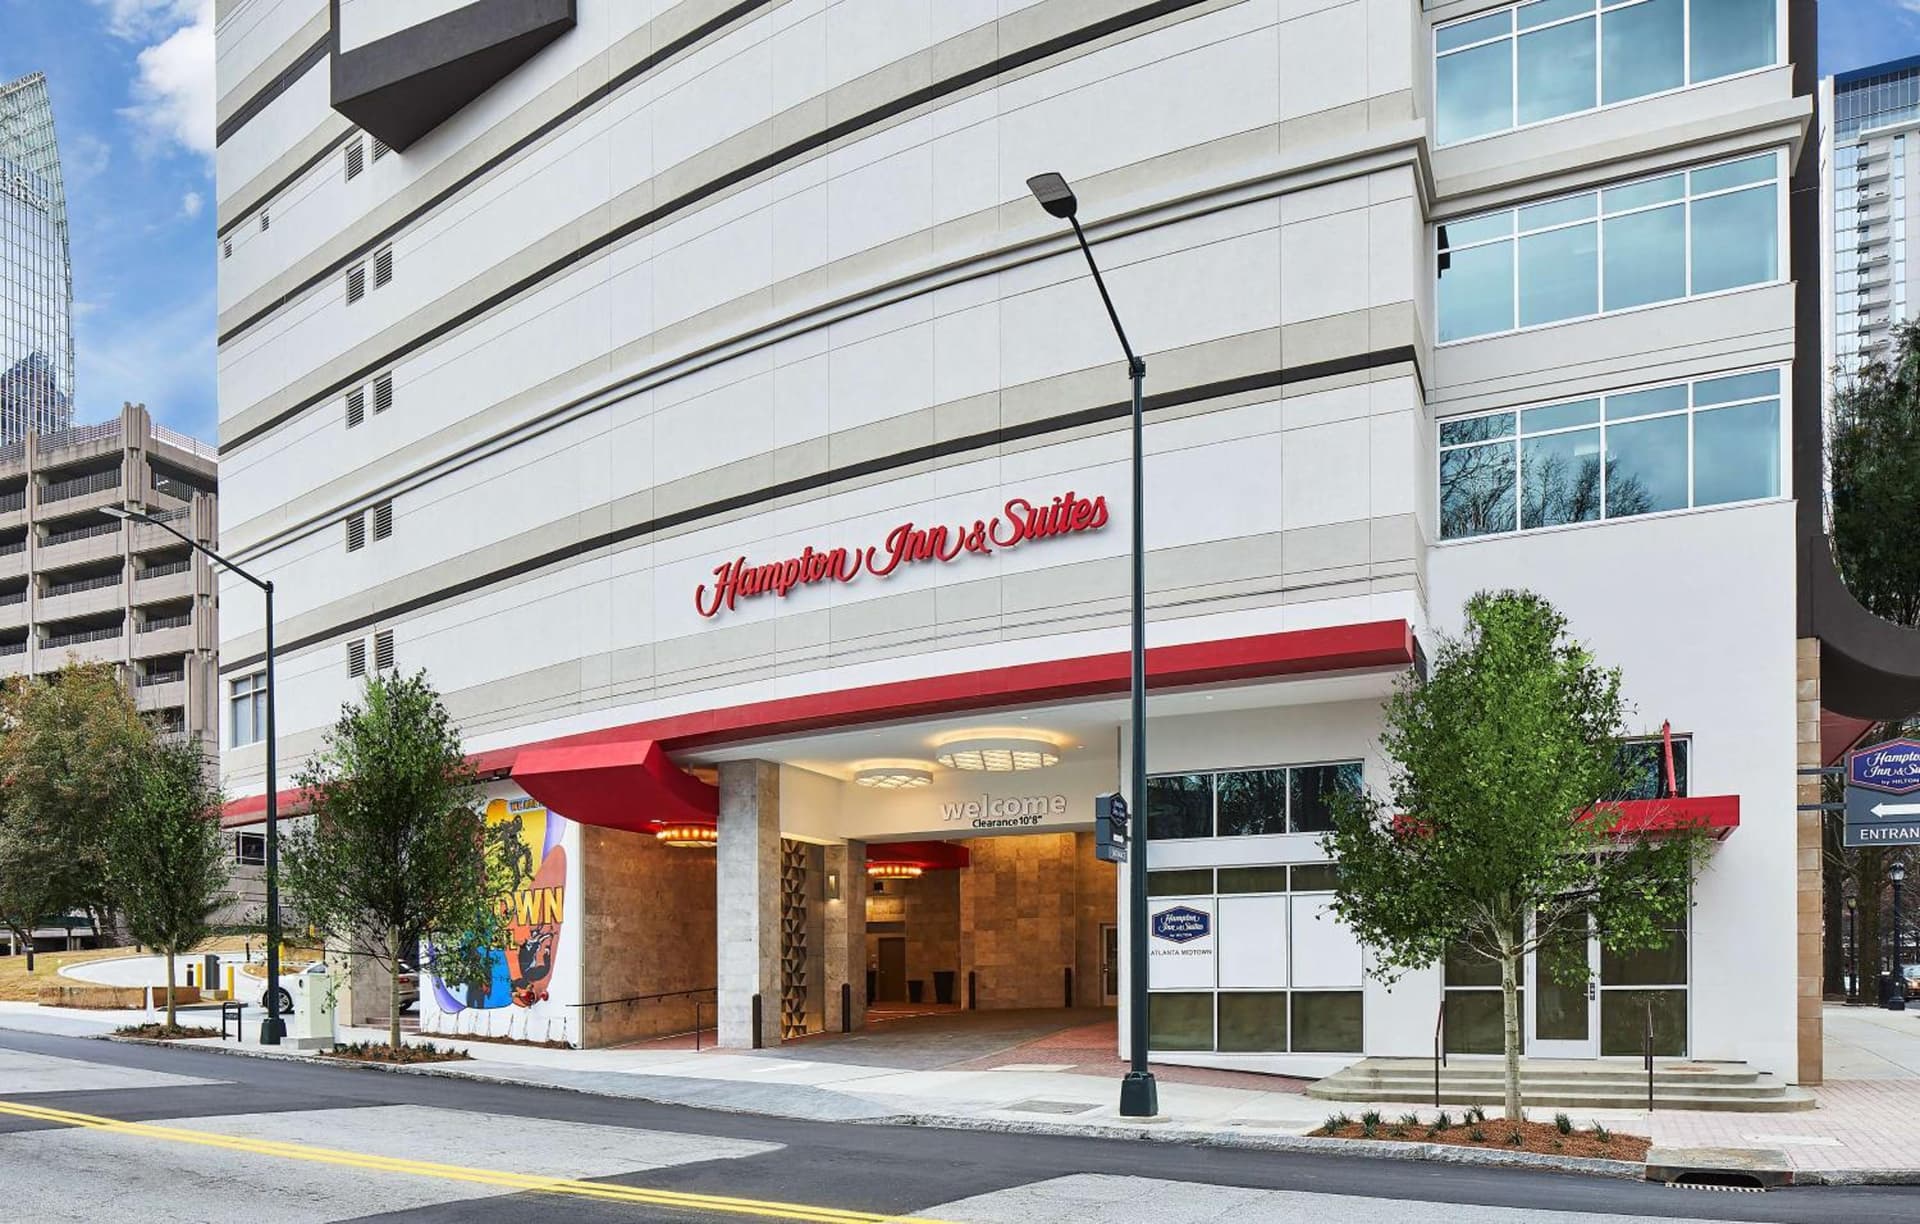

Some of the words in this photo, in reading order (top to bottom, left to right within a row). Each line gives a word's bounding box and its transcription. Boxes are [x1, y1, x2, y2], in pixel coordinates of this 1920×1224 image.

[695, 545, 862, 617] Hampton
[866, 522, 965, 576] Inn
[965, 520, 992, 554] &
[989, 491, 1109, 547] Suites
[1863, 765, 1897, 778] Inn
[1896, 766, 1905, 776] &
[941, 792, 1067, 821] welcome
[972, 817, 1018, 828] Clearance
